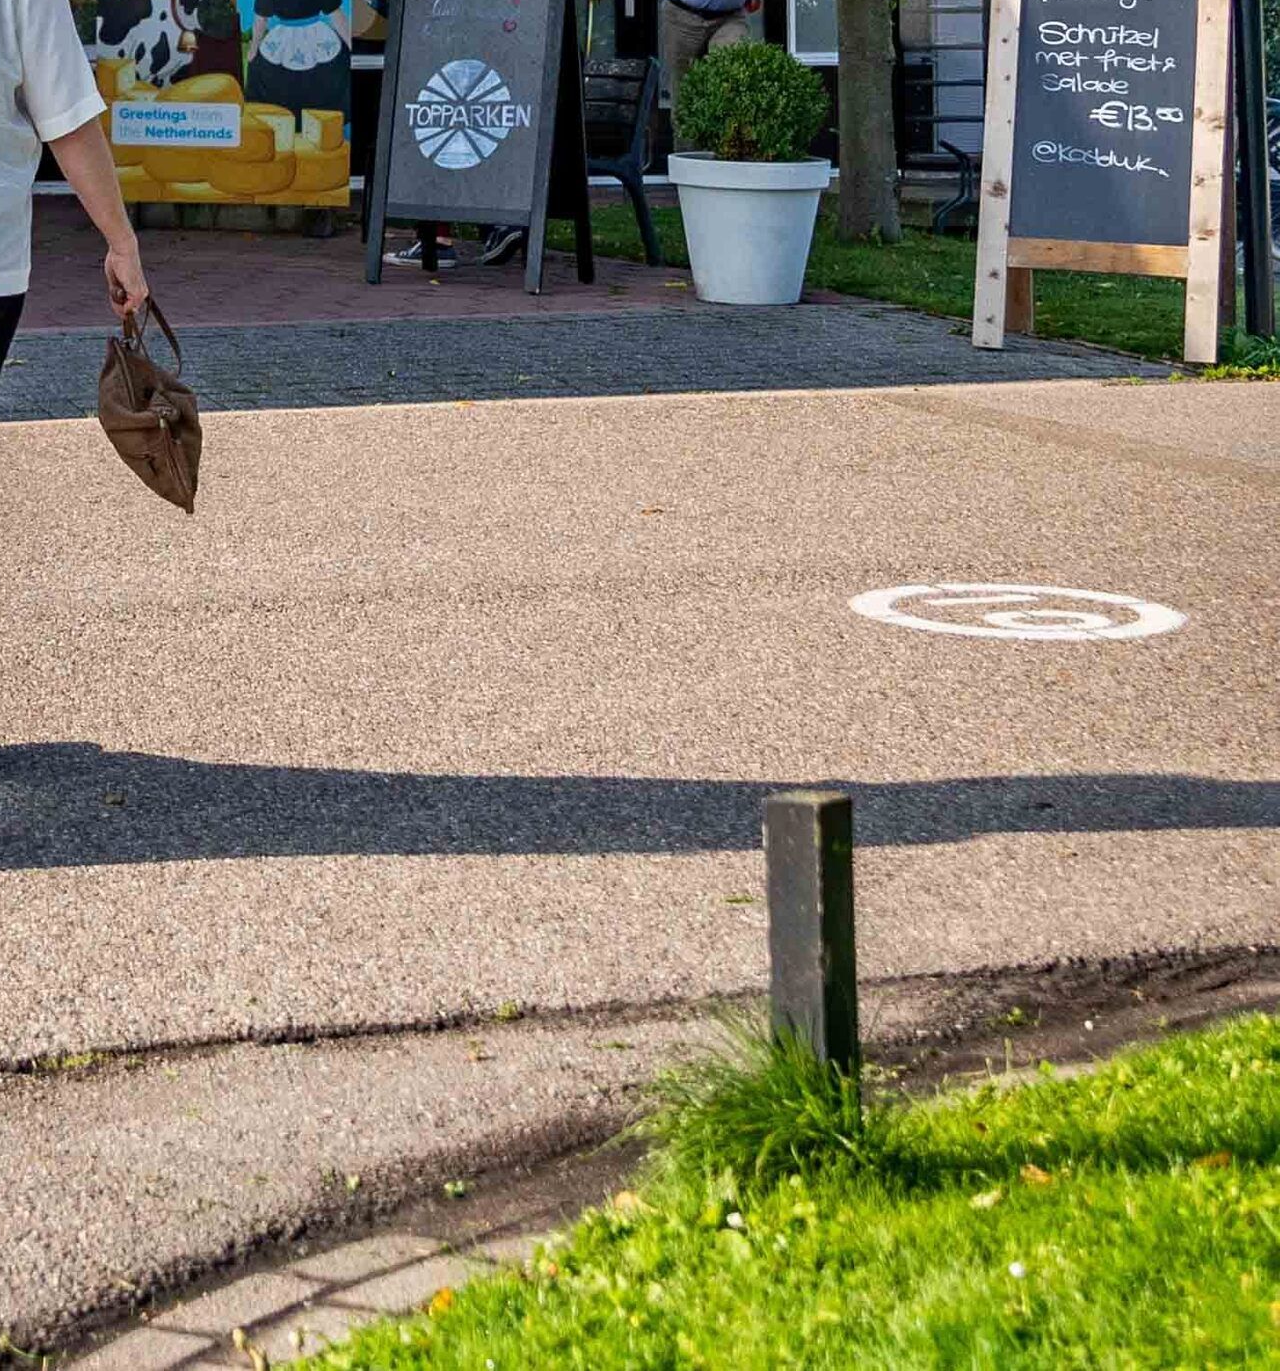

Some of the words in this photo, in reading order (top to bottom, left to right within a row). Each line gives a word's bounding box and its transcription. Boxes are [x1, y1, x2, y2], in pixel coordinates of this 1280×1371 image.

[1038, 21, 1159, 49] Schnitzel
[1035, 50, 1089, 67] met
[118, 107, 187, 124] Greetings
[404, 102, 532, 128] TOPPARKEN
[144, 125, 234, 140] Netherlands
